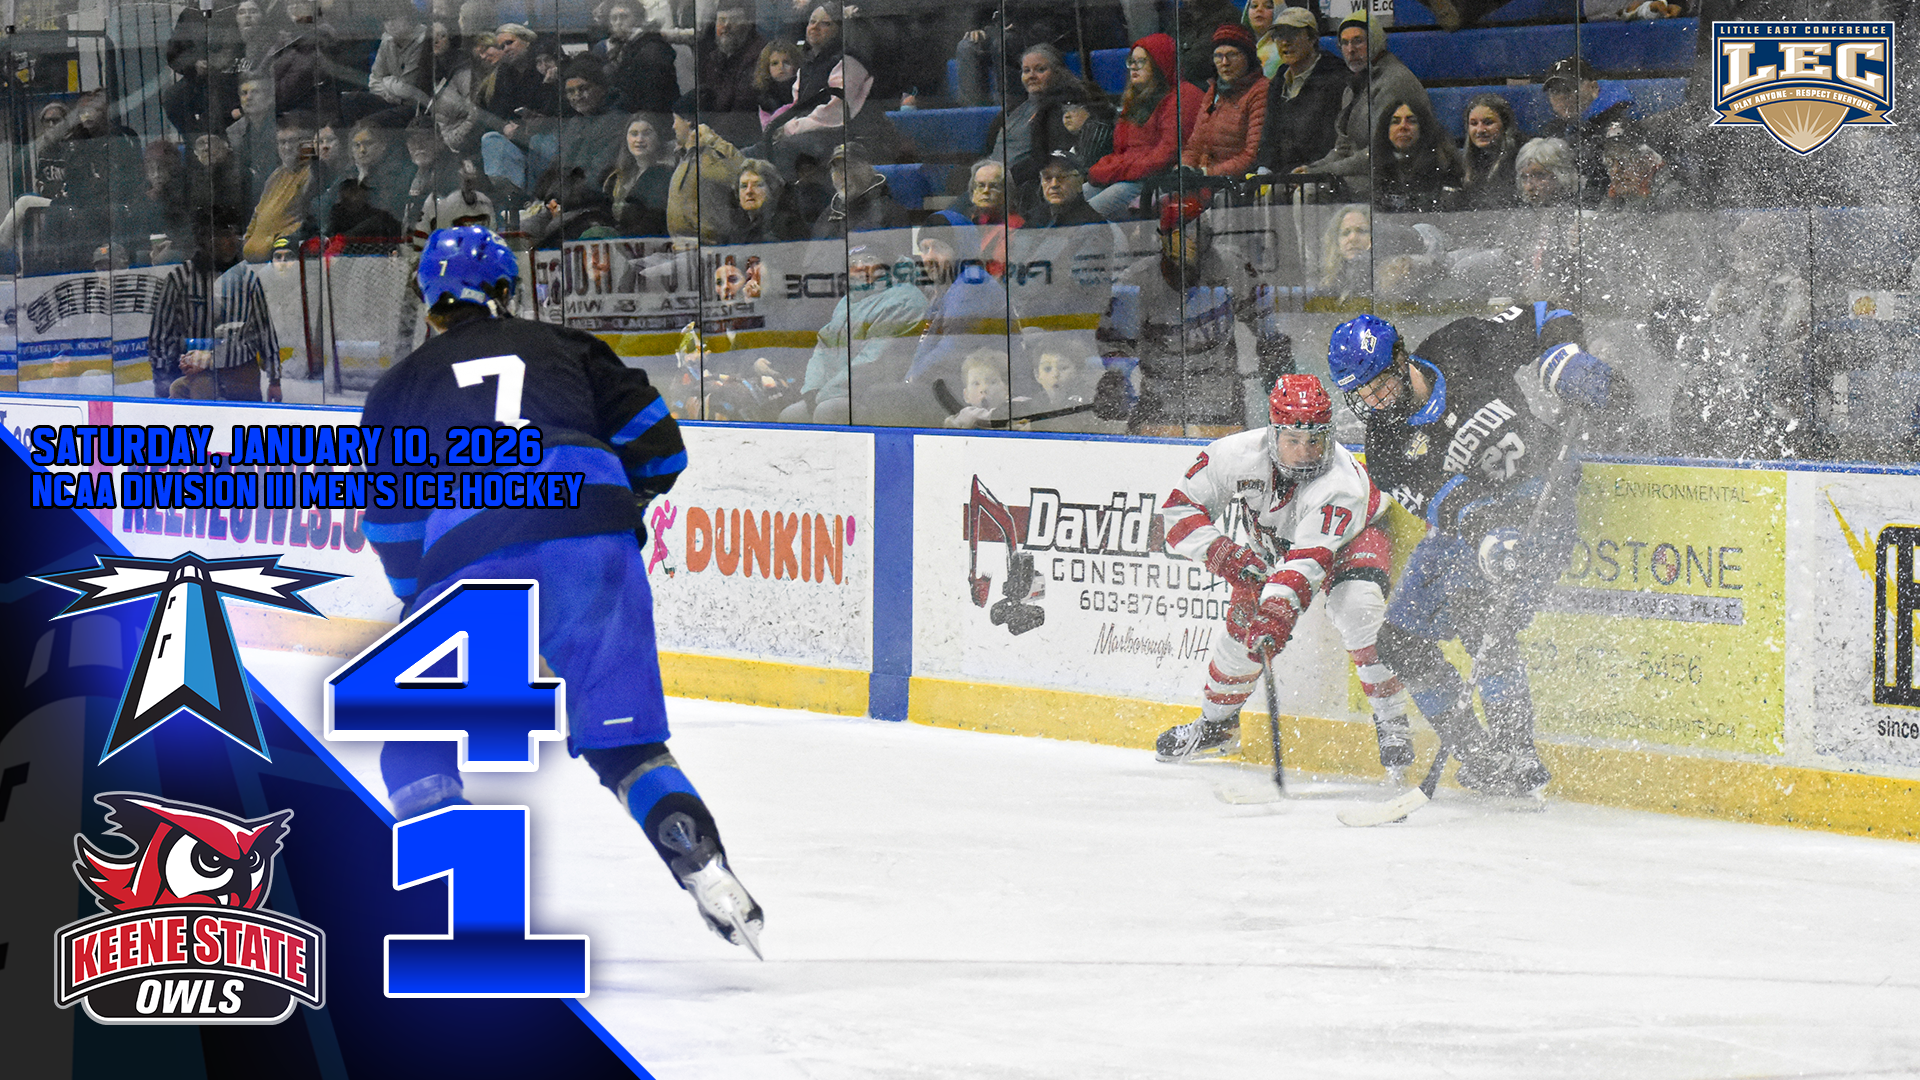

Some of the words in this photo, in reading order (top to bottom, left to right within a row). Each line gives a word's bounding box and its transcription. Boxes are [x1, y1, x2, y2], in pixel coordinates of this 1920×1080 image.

[439, 260, 448, 277] 7
[451, 354, 530, 428] 7
[1443, 398, 1517, 473] BOSTON
[1614, 478, 1750, 503] ENVIRONMENTAL
[1023, 487, 1157, 558] David
[1320, 504, 1353, 537] 17
[686, 506, 856, 586] DUNKIN'
[1177, 627, 1213, 662] NH
[1877, 716, 1920, 739] since
